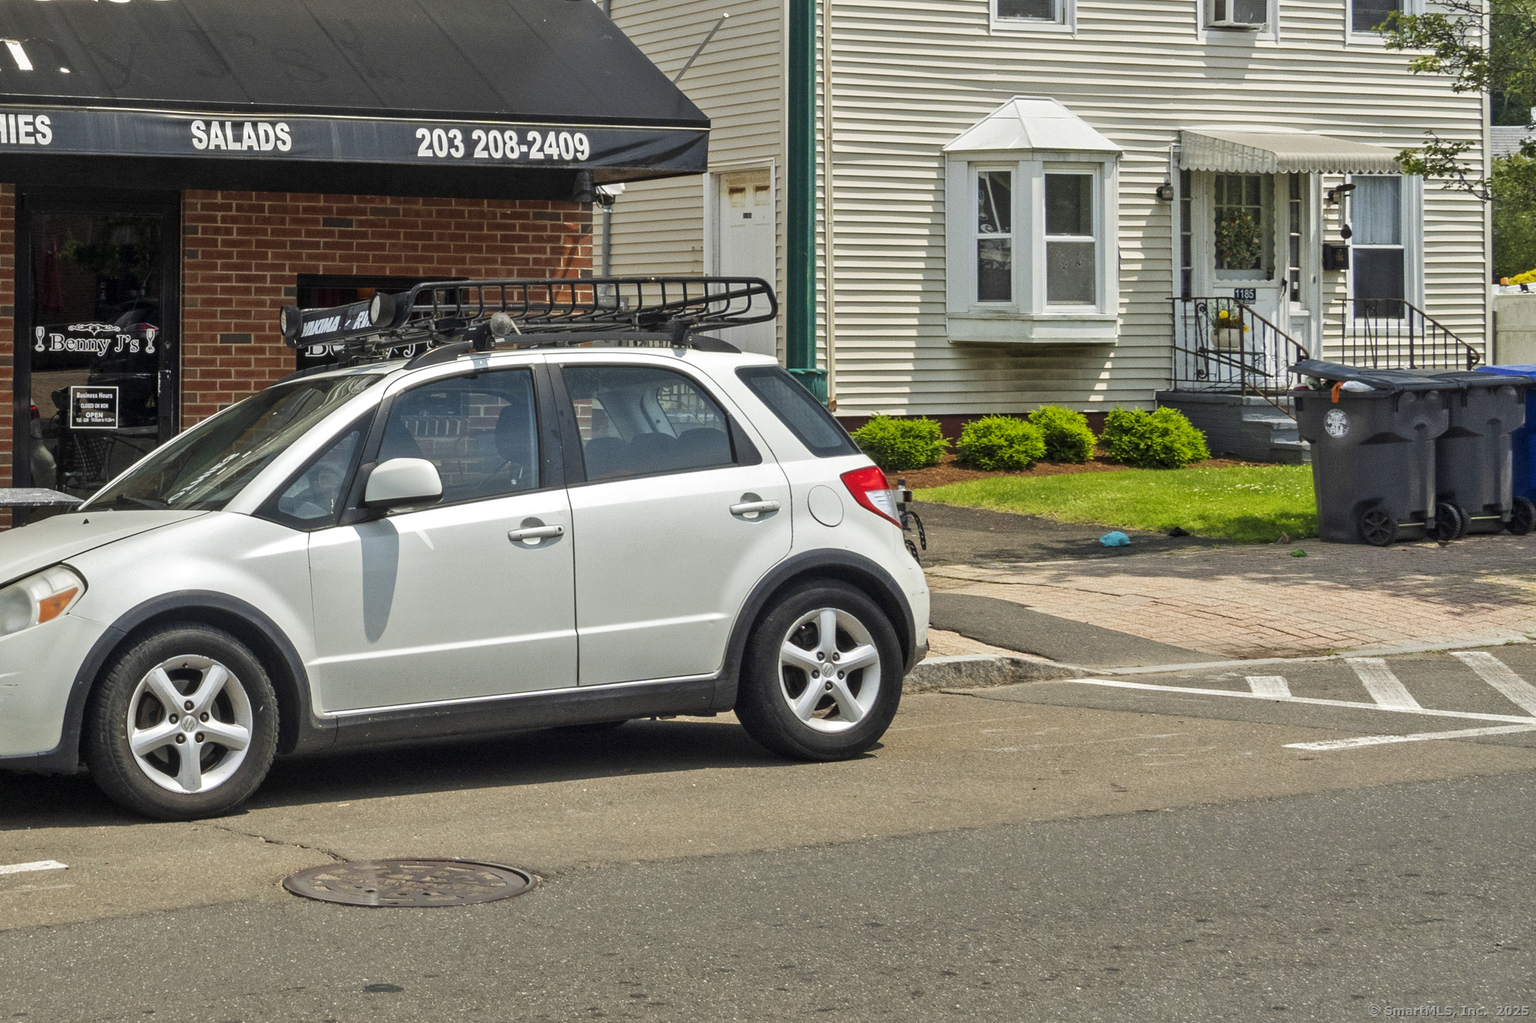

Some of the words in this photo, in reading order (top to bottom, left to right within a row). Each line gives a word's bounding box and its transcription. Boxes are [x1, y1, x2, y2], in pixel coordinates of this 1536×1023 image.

[191, 120, 293, 152] SALADS
[415, 127, 465, 158] 203
[471, 129, 591, 161] 208-2409
[1235, 289, 1255, 299] 1185
[300, 315, 342, 338] YAKIMA
[48, 333, 112, 357] Benny
[114, 334, 140, 353] J's
